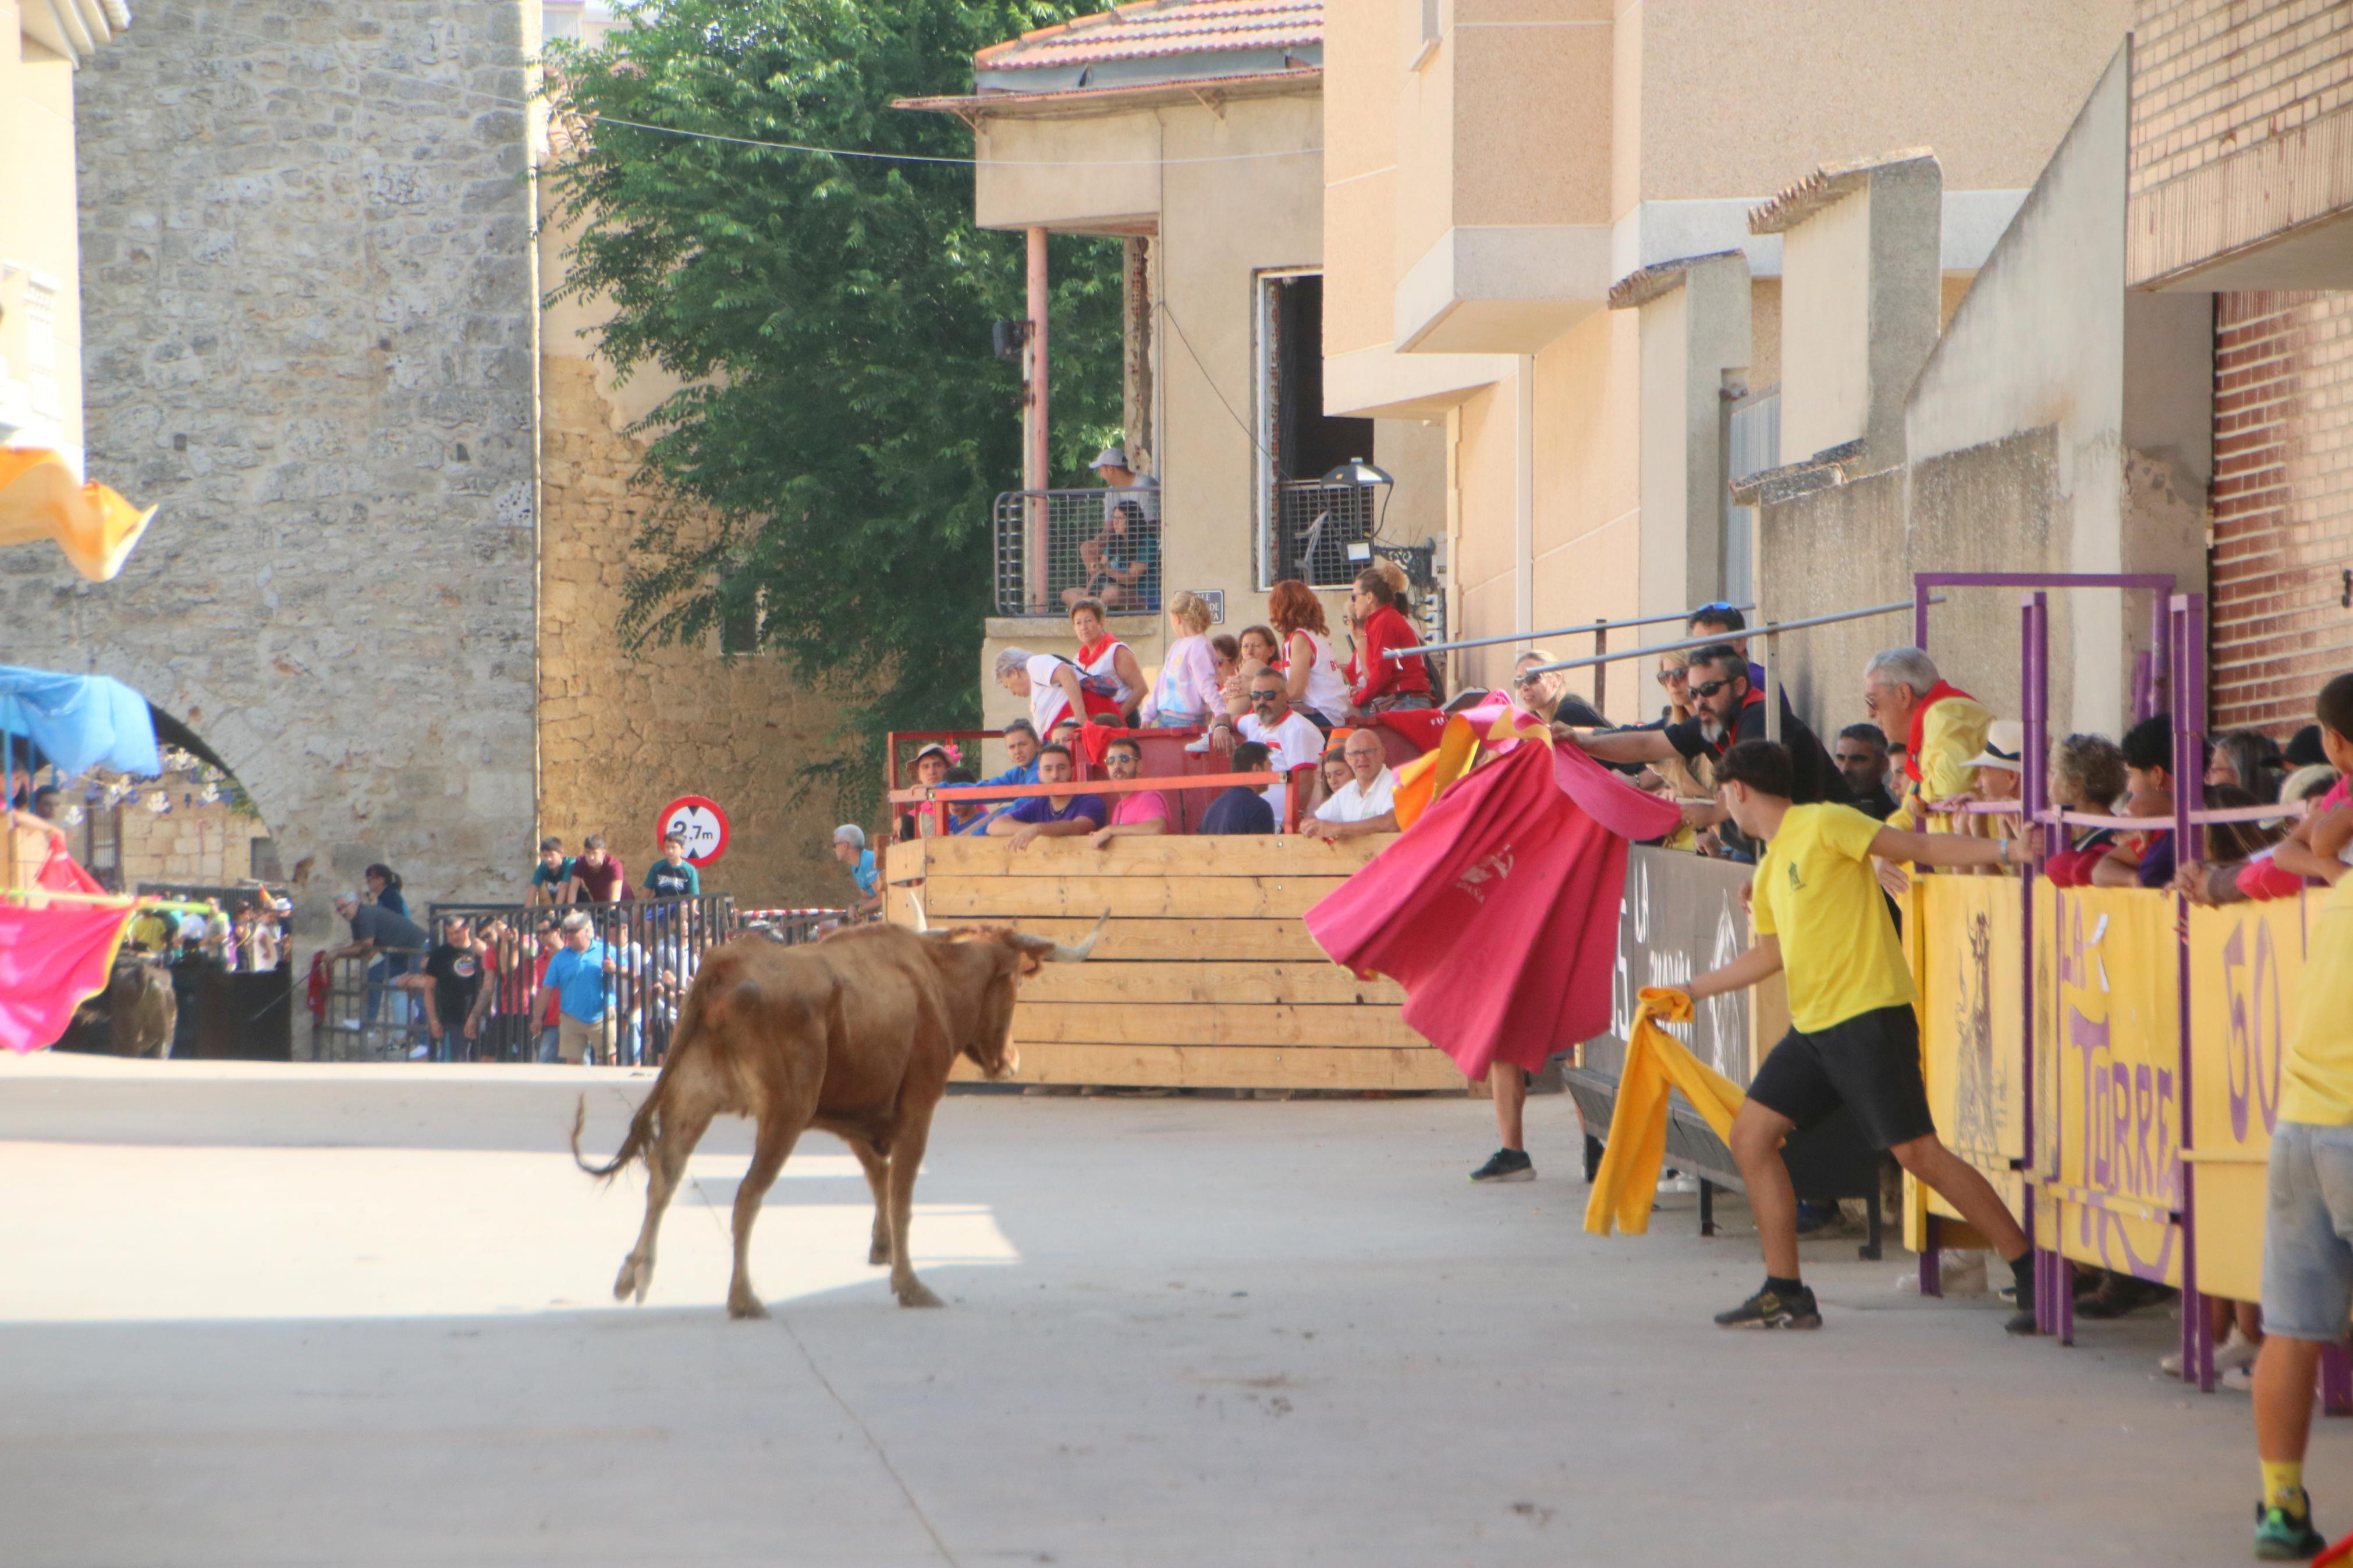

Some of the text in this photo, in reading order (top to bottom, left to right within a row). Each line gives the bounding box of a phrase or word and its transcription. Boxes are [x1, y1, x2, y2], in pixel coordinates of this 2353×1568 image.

[1634, 855, 1649, 944] LA
[2061, 891, 2086, 990] LA
[2222, 914, 2281, 1144] 50
[2069, 1004, 2177, 1249] TORRE
